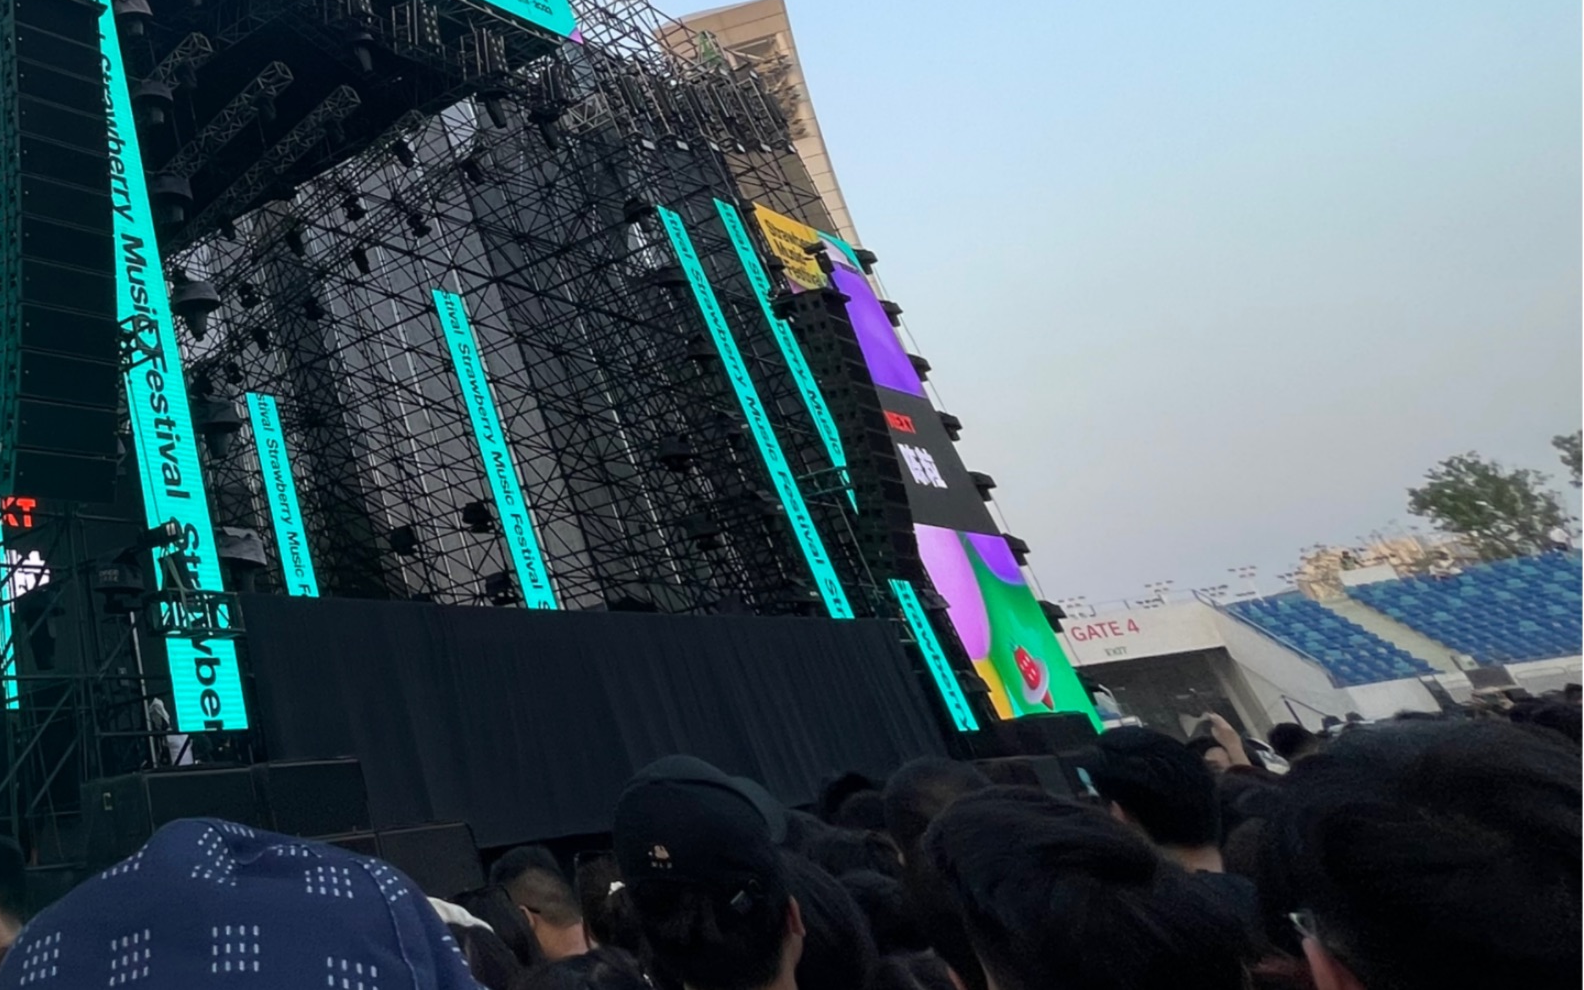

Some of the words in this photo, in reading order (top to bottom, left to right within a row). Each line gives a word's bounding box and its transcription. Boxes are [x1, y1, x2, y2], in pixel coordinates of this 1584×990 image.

[691, 268, 748, 388] Strawberry
[746, 395, 778, 462] Music
[777, 471, 825, 565] Festival
[807, 389, 841, 455] Music
[884, 410, 916, 434] NEXT
[457, 342, 497, 444] Strawberry
[490, 451, 515, 507] Music
[510, 513, 544, 590] Festival
[266, 438, 294, 526] Strawberry
[287, 531, 305, 578] Music
[1071, 621, 1124, 642] GATE
[1127, 618, 1140, 634] 4
[1104, 646, 1128, 657] EXIT
